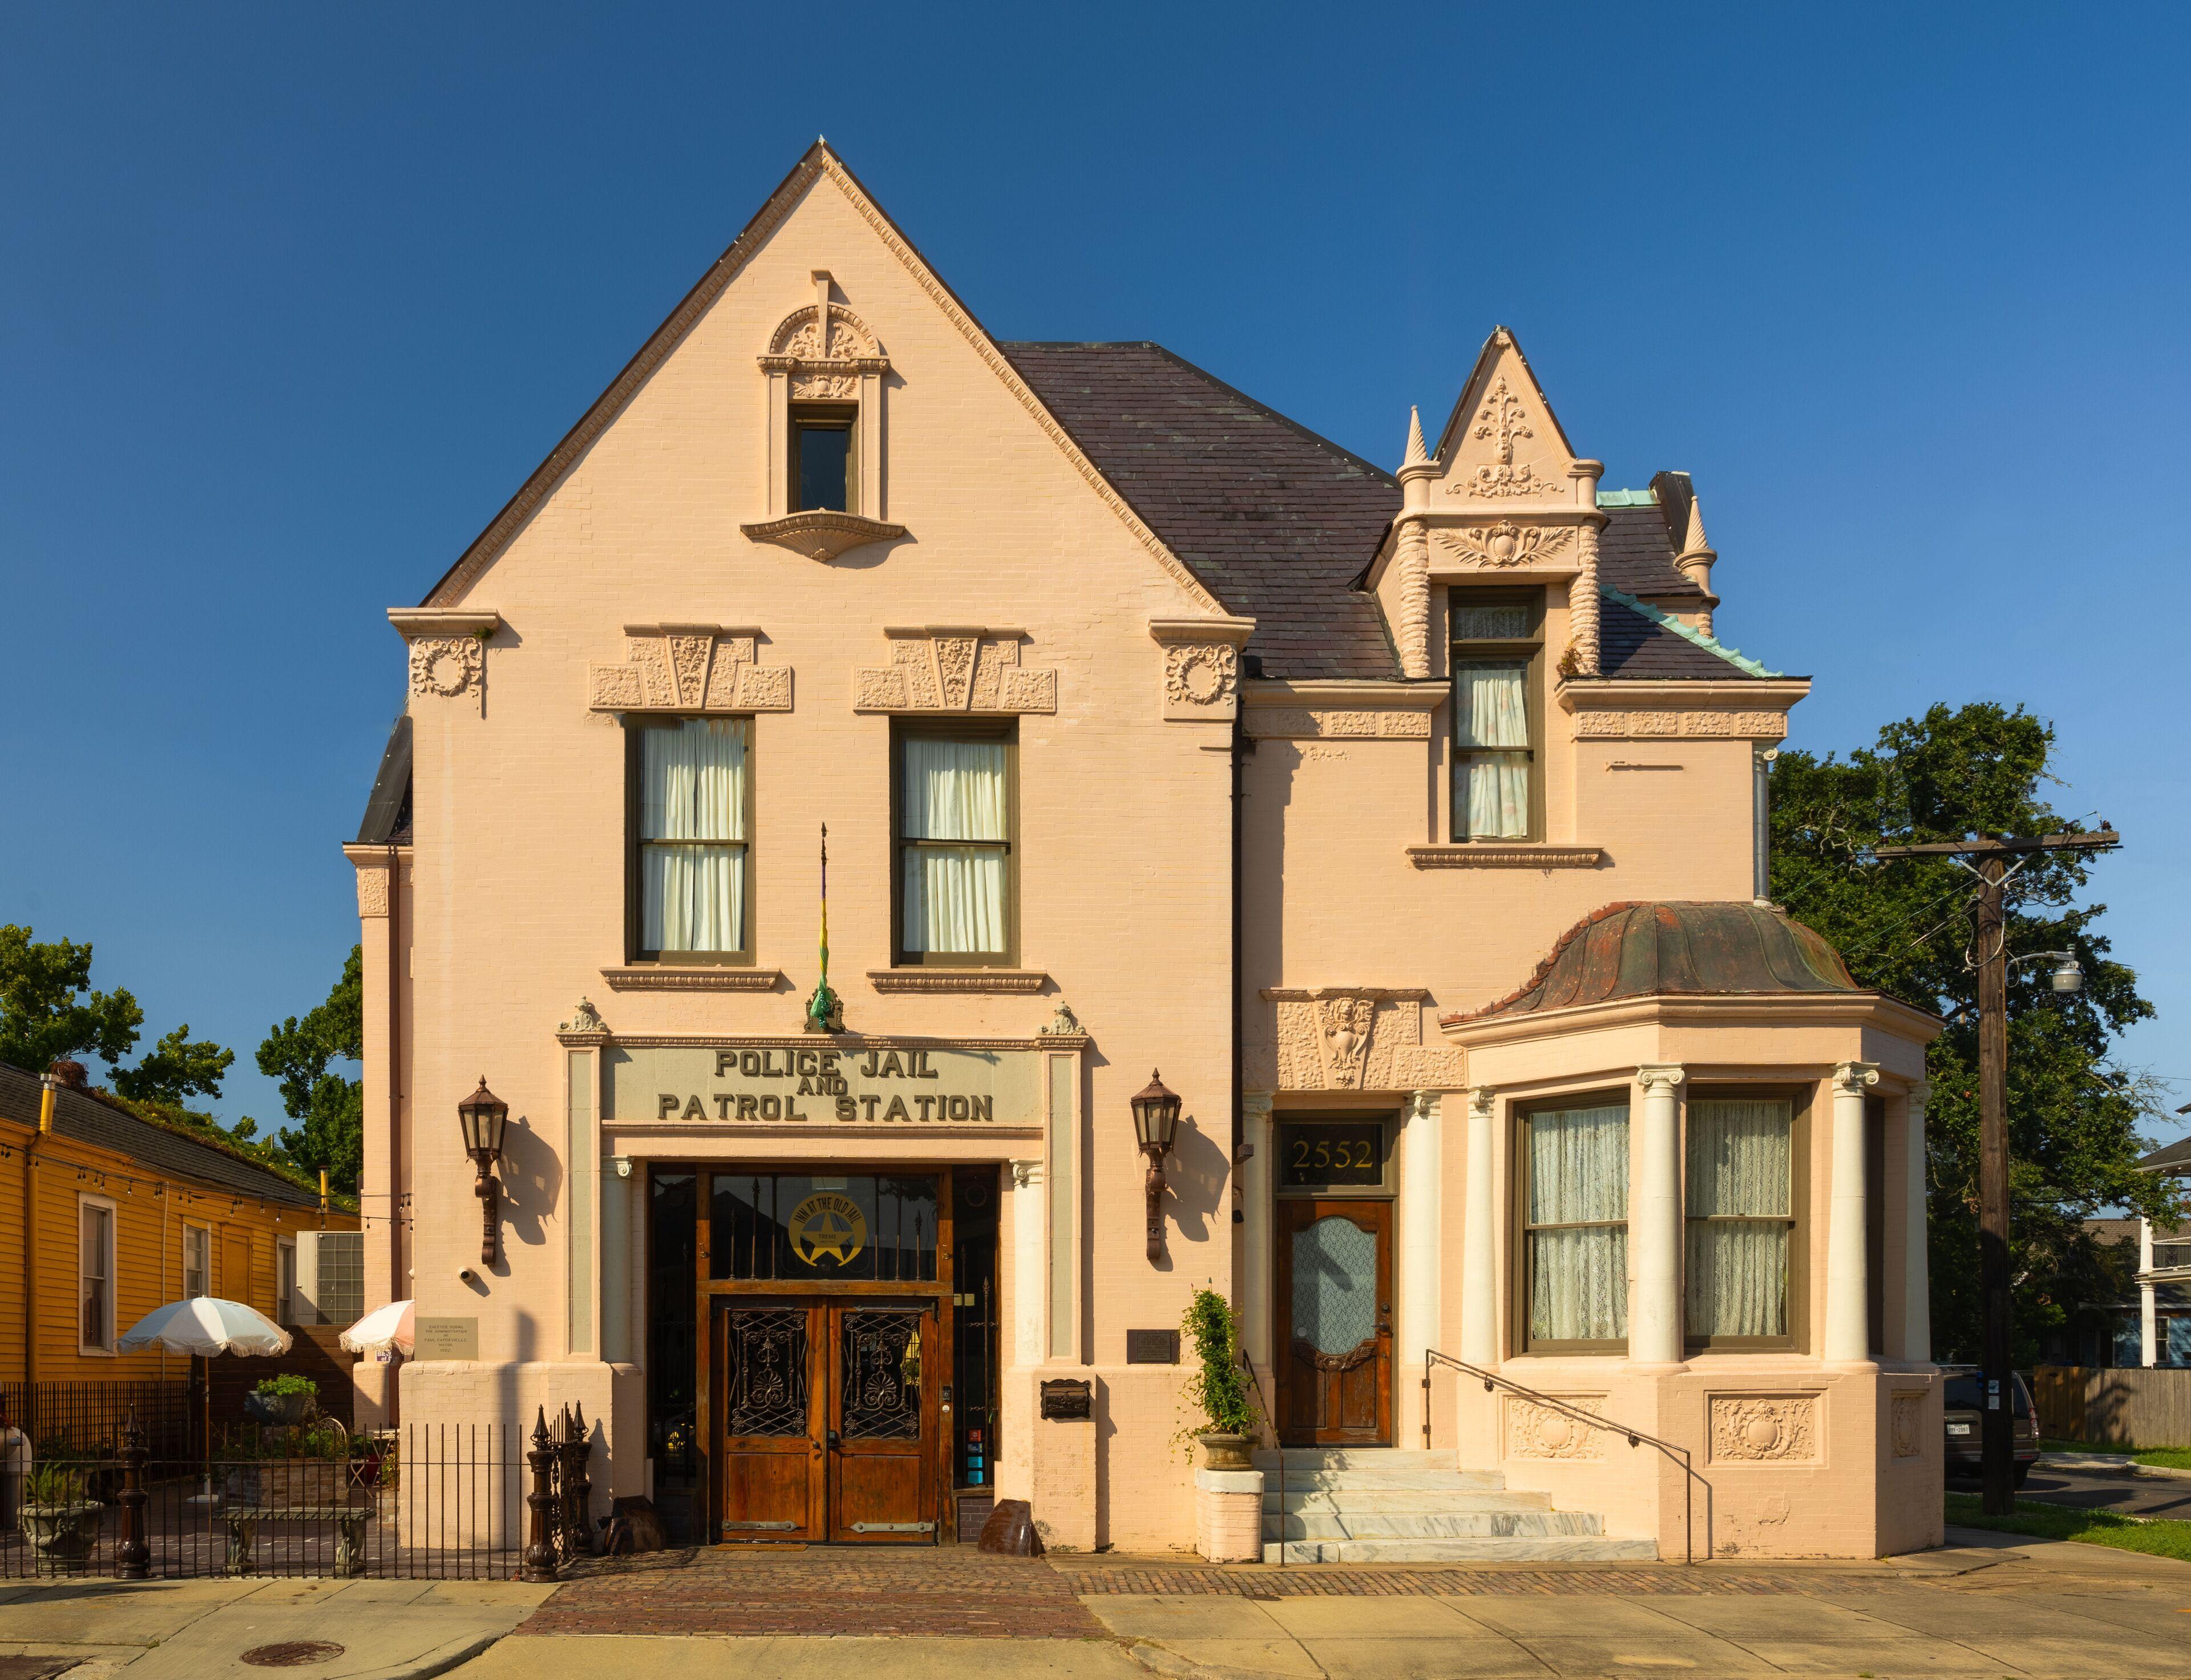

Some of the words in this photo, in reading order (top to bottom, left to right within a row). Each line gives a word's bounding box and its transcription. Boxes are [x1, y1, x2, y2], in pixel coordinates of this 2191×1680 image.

[714, 1050, 840, 1078] POLICE
[860, 1050, 937, 1078] JAIL
[797, 1076, 848, 1096] AND
[657, 1094, 806, 1122] PATROL
[835, 1094, 993, 1122] STATION
[1292, 1140, 1373, 1168] 2552
[794, 1208, 810, 1224] INN
[806, 1200, 818, 1215] AT
[816, 1197, 832, 1211] THE
[833, 1198, 850, 1213] OLD
[847, 1207, 862, 1224] JAIL
